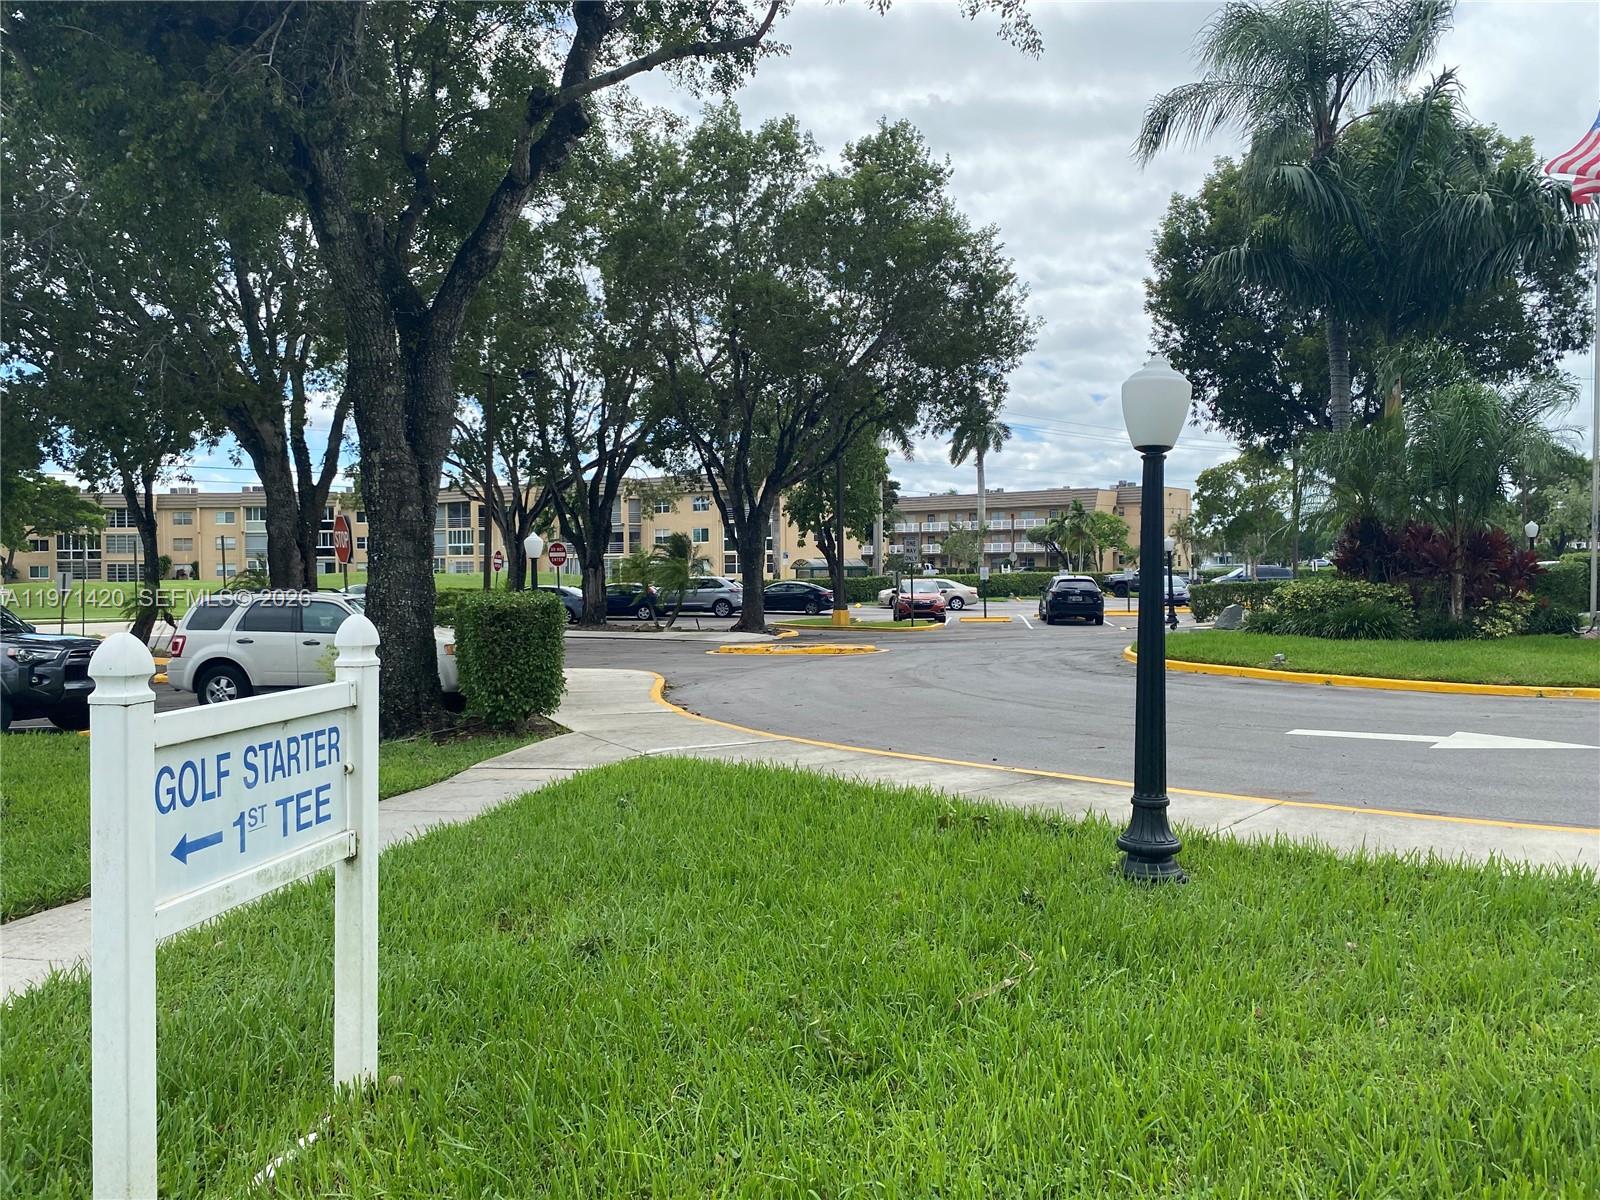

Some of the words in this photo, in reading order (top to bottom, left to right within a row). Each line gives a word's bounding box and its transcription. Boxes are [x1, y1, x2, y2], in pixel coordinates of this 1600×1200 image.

[334, 531, 348, 548] STOP
[155, 751, 231, 815] GOLF
[243, 726, 340, 790] STARTER
[233, 804, 267, 853] 1ST
[275, 783, 332, 838] TEE
